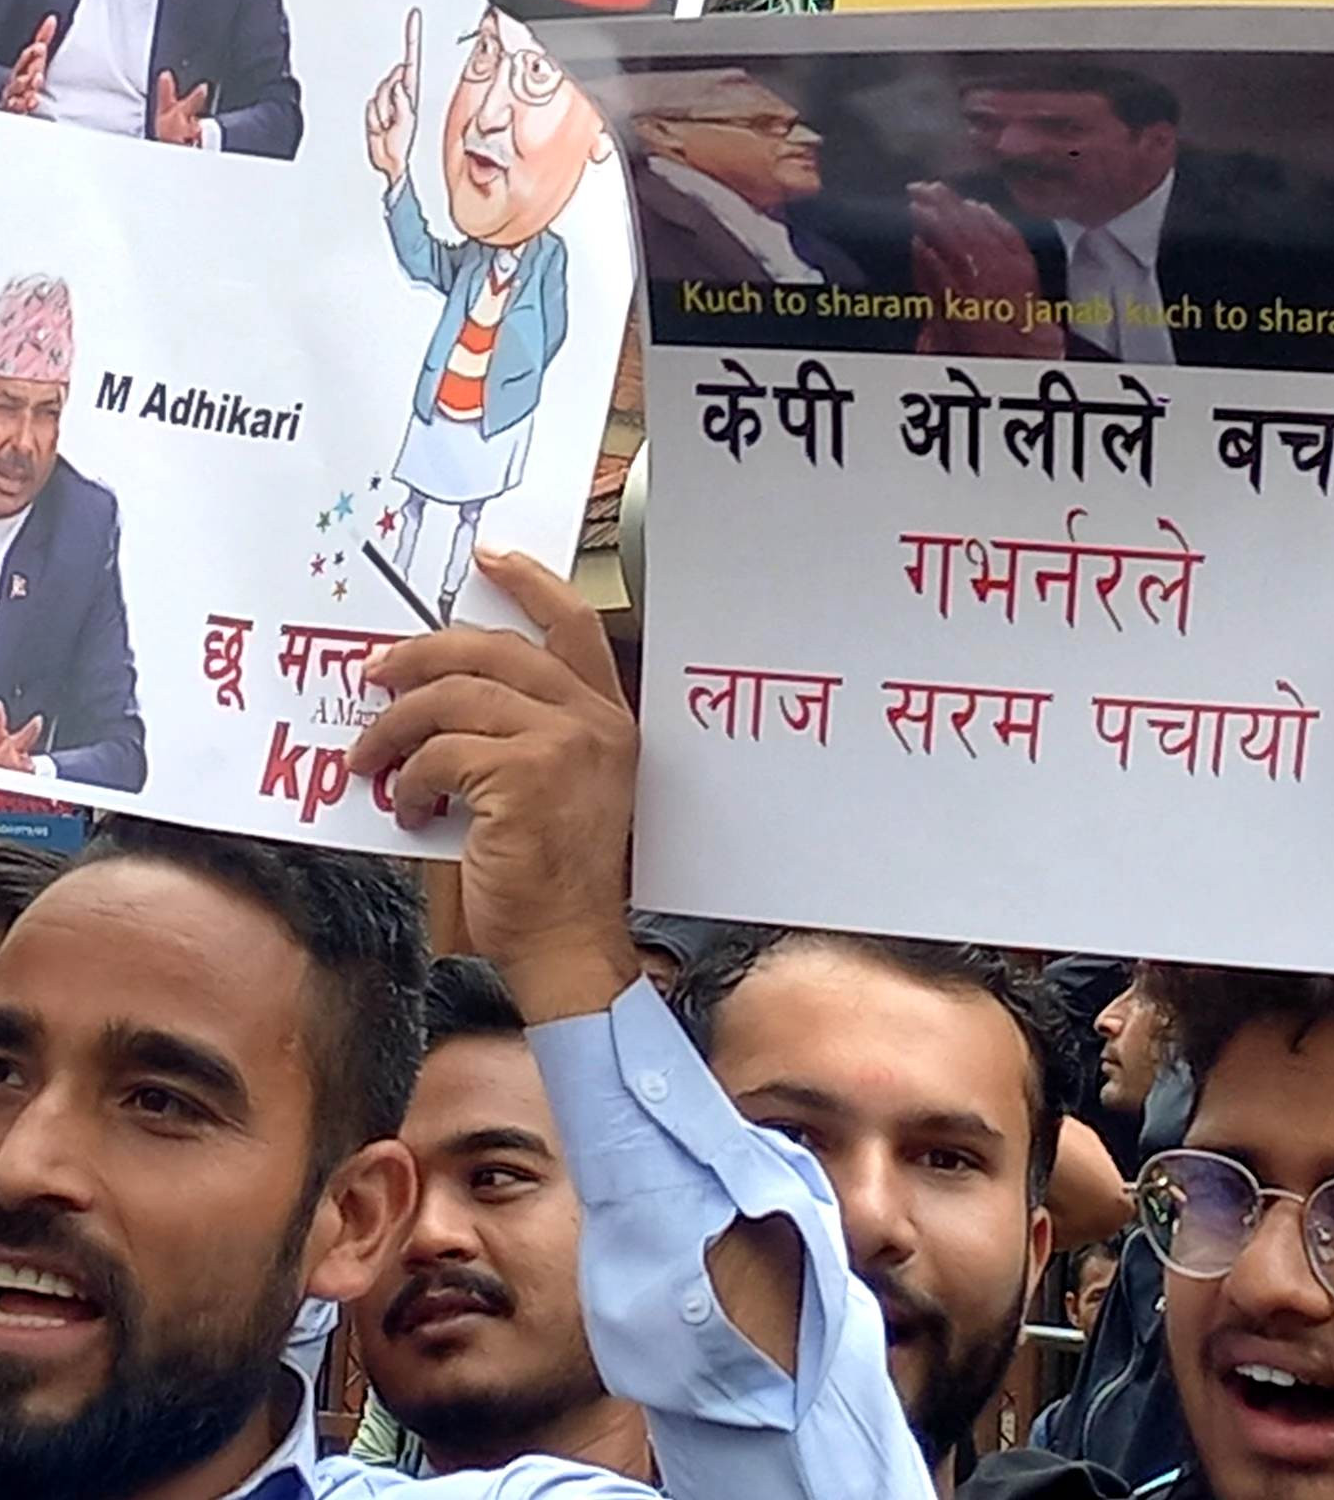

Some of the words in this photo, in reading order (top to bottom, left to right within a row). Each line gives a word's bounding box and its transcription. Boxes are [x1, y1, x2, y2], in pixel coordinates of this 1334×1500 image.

[682, 281, 763, 316] Kuch
[773, 287, 806, 318] to
[817, 284, 934, 321] sharam
[944, 287, 1015, 323] karo
[1021, 293, 1113, 333] janab
[1215, 300, 1248, 331] to
[96, 372, 133, 413] M
[139, 382, 303, 441] Adhikari
[696, 358, 854, 468] केपी
[900, 367, 1170, 487] ओलीले
[259, 721, 349, 823] kp
[684, 666, 843, 747] लाज
[881, 682, 1053, 763] सरम
[1091, 680, 1320, 782] पचायो
